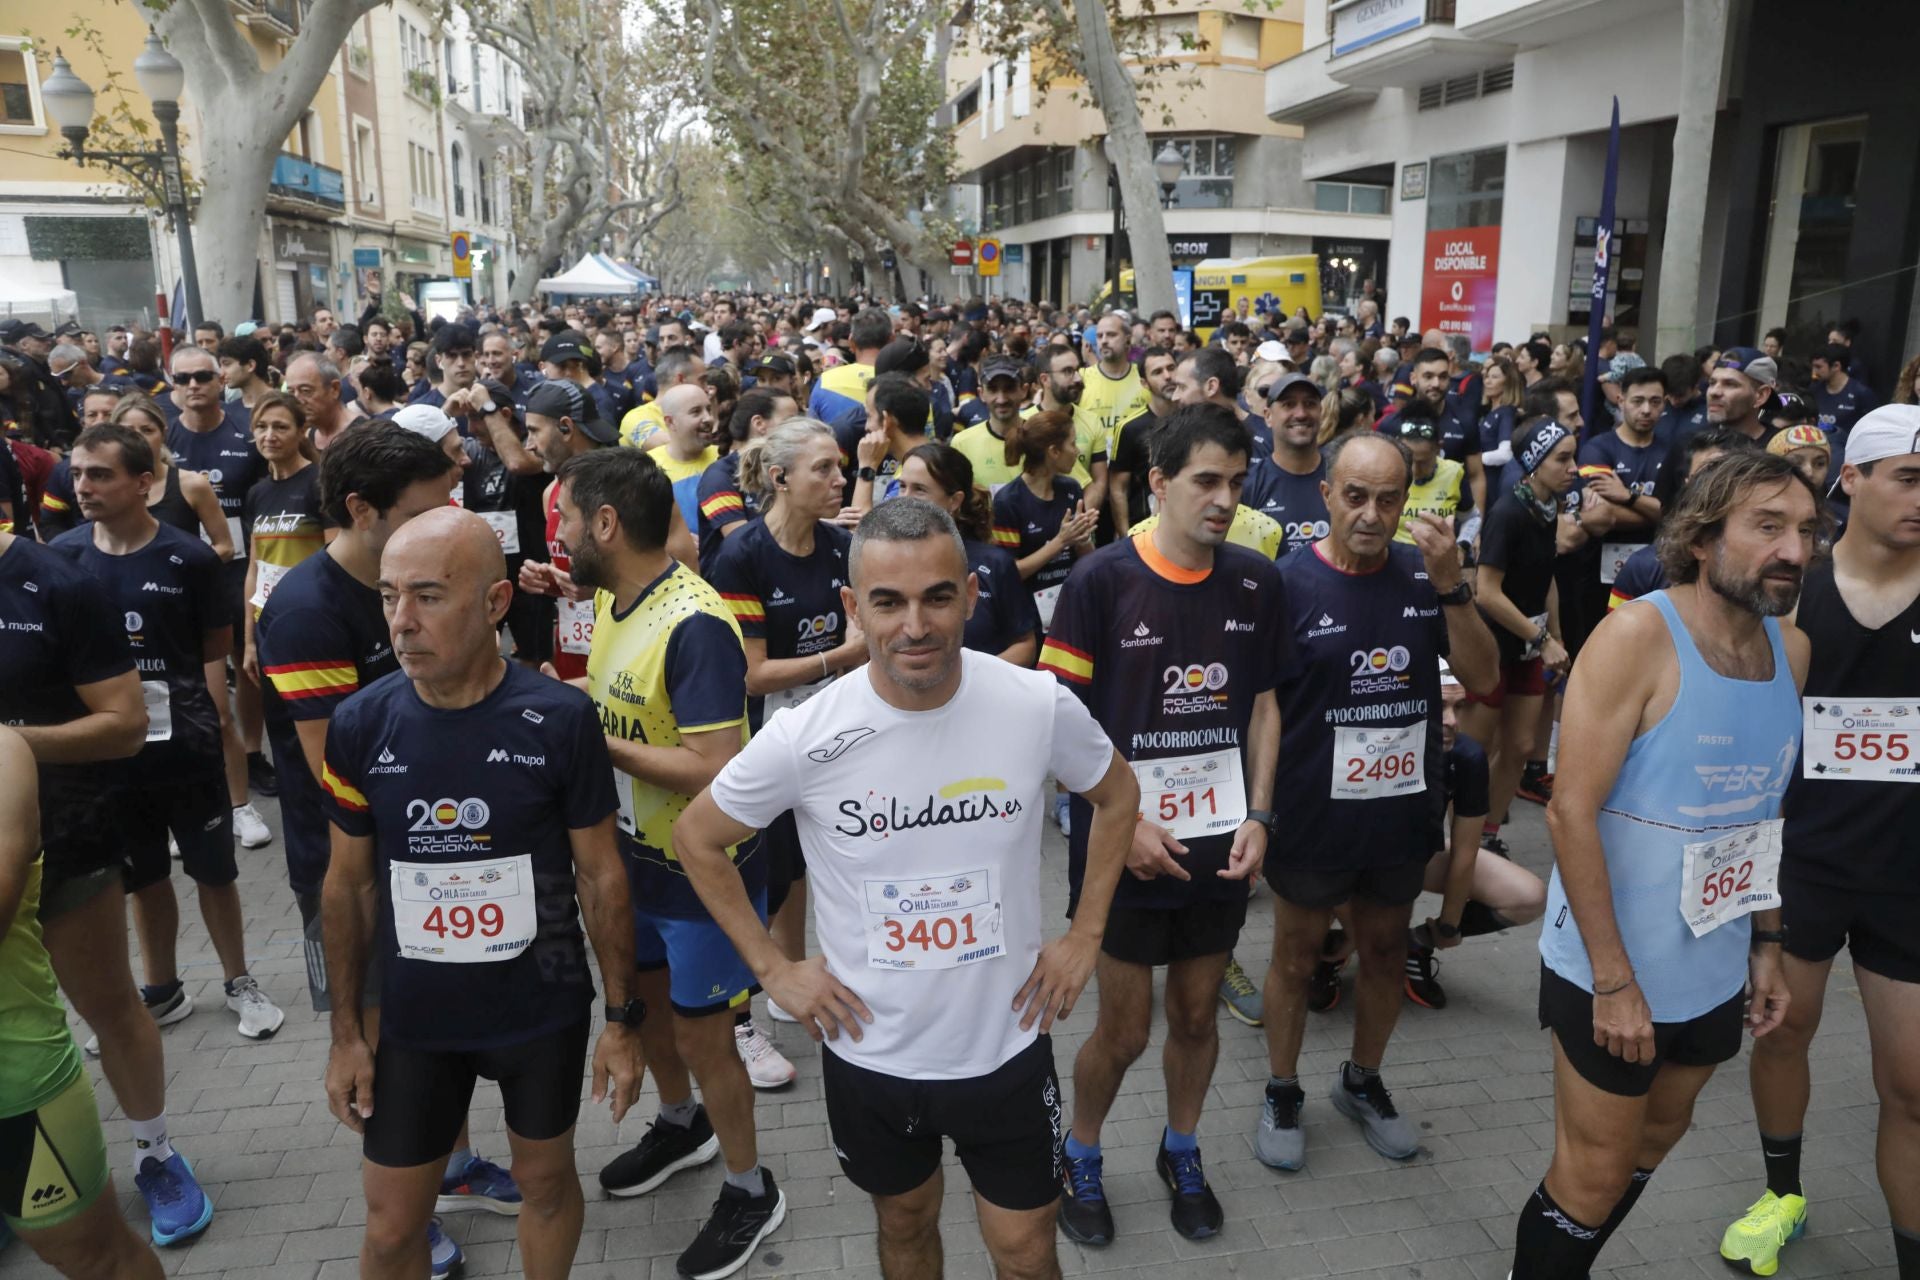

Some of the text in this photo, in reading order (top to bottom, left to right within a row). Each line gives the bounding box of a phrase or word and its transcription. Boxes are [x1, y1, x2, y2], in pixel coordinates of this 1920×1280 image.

[1445, 242, 1474, 256] LOCAL
[1434, 256, 1487, 271] DISPONIBLE
[1285, 520, 1330, 541] 200
[8, 621, 43, 632] mupol
[797, 612, 838, 640] 200
[1307, 625, 1347, 638] Santander
[1120, 636, 1163, 648] Santander
[1350, 645, 1410, 677] 200
[1163, 662, 1229, 695] 200
[1351, 676, 1398, 687] POLICIA
[1351, 682, 1409, 695] NACIONAL
[621, 691, 647, 706] CORRE
[1163, 695, 1214, 706] POLICIA
[1163, 703, 1229, 715] NACIONAL
[1856, 720, 1870, 728] HLA
[1697, 735, 1735, 744] FASTER
[1834, 733, 1910, 762] 555
[513, 754, 546, 766] mupol
[1347, 752, 1416, 783] 2496
[1160, 787, 1217, 821] 511
[406, 797, 490, 832] 200
[408, 834, 474, 845] POLICIA
[409, 844, 491, 854] NACIONAL
[1702, 860, 1754, 906] 562
[444, 889, 459, 899] HLA
[915, 900, 930, 911] HLA
[422, 903, 505, 939] 499
[883, 912, 978, 952] 3401
[485, 938, 530, 953] #RUTA091
[957, 945, 1000, 963] #RUTA091
